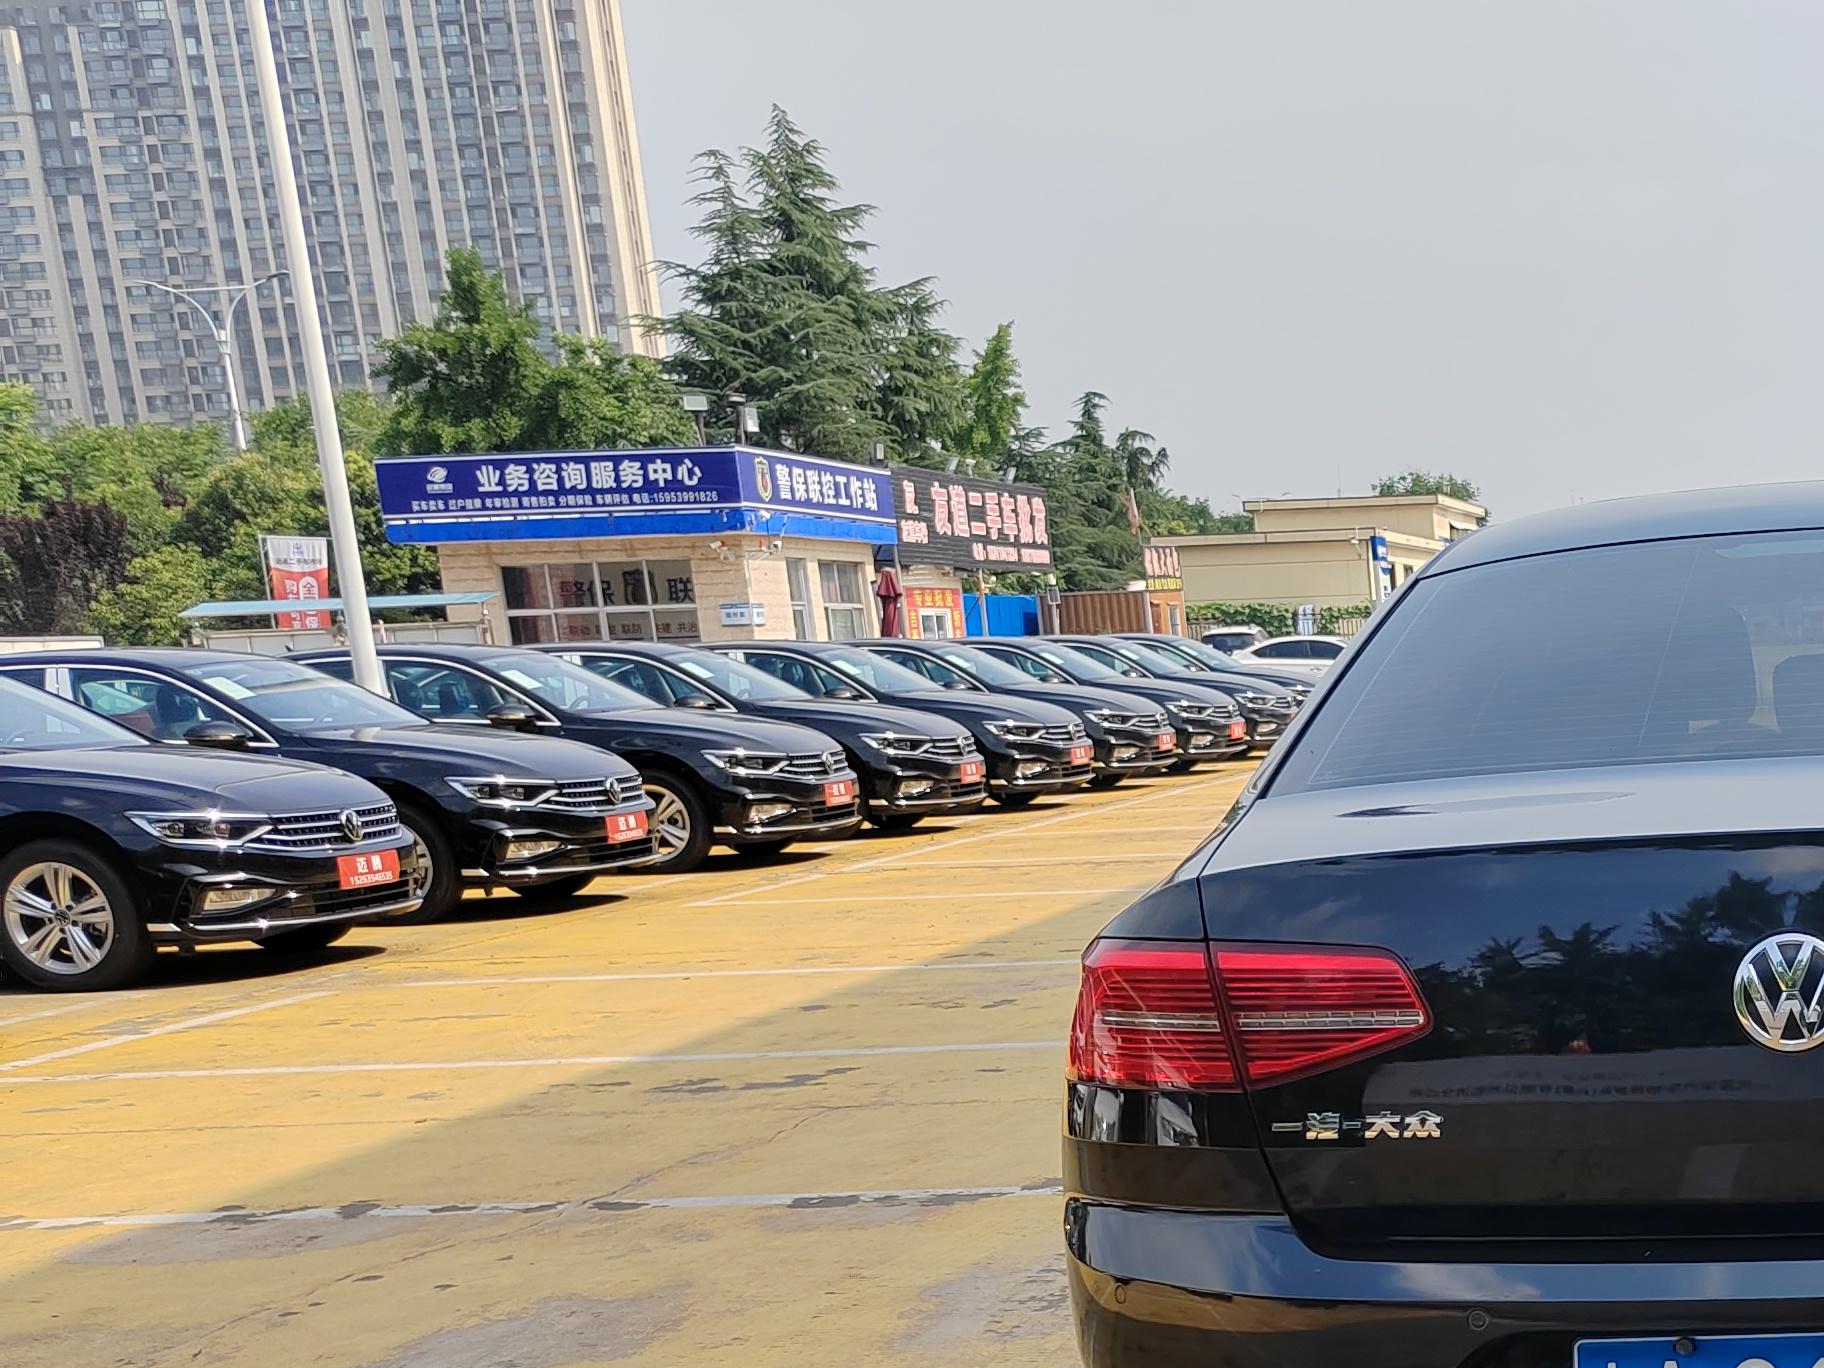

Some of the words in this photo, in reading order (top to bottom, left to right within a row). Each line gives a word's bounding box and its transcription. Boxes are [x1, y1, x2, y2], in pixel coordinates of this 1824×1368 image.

[475, 458, 702, 493] 业务咨询服务中心
[775, 464, 879, 511] 警保联控工作站
